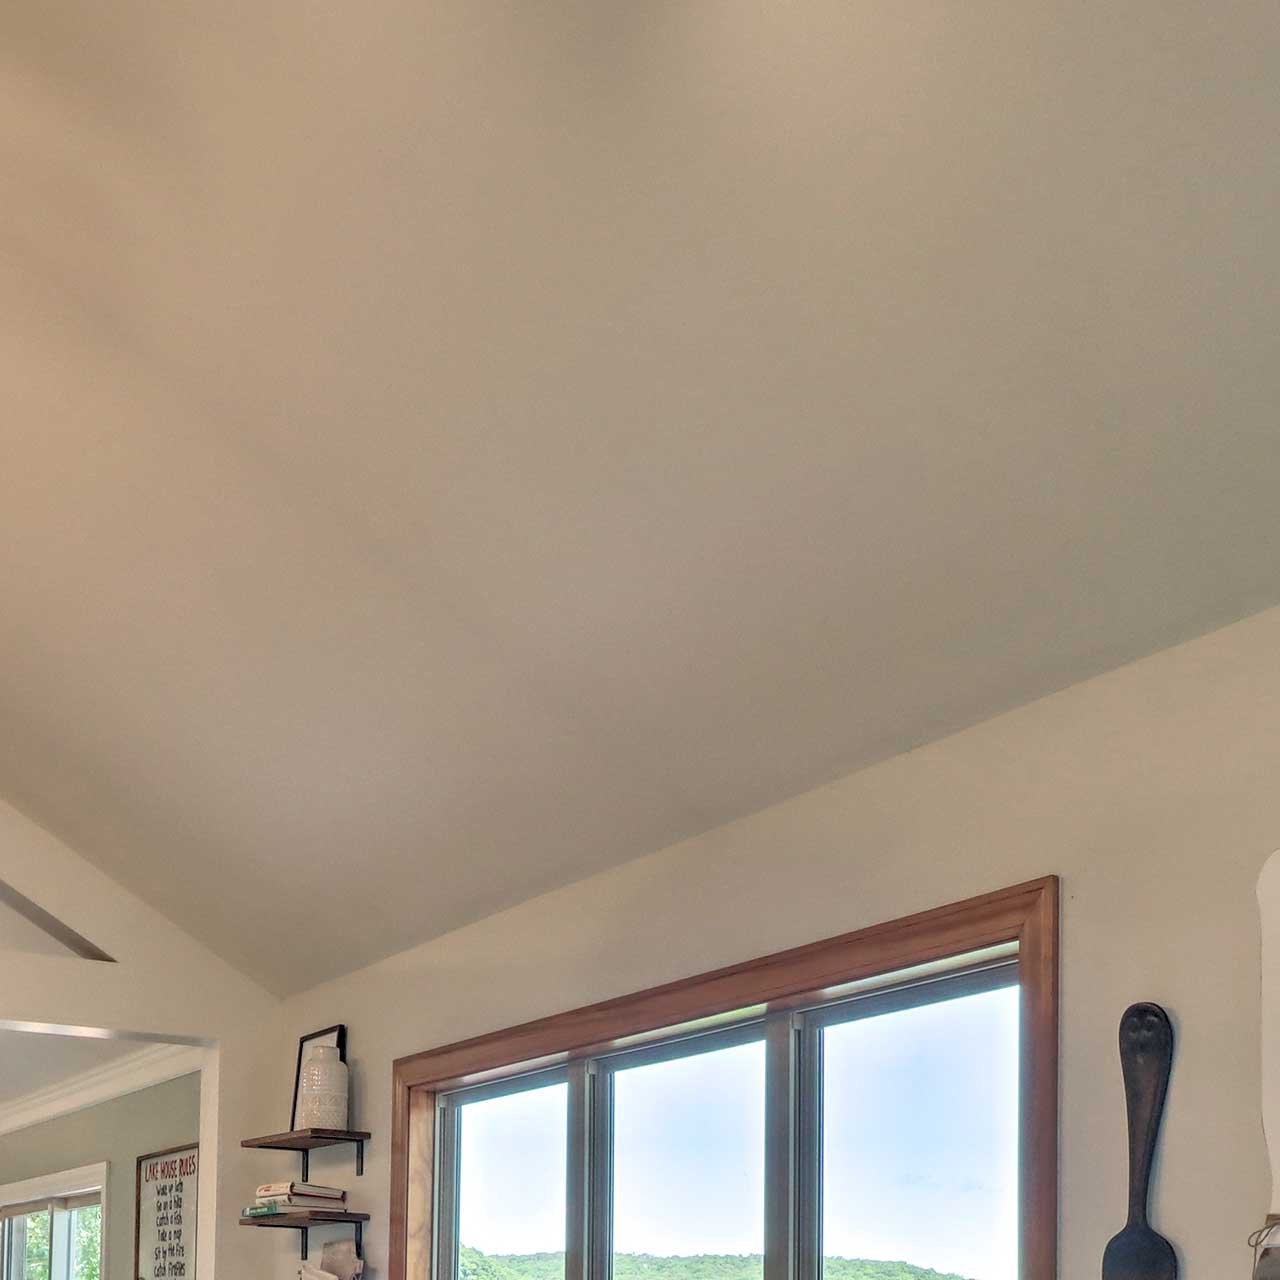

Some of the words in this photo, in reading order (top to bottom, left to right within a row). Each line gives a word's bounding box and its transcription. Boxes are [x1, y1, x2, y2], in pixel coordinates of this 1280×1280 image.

[145, 1162, 159, 1182] LAKE
[160, 1159, 177, 1180] HOUSE
[179, 1154, 196, 1177] RULES
[156, 1184, 168, 1197] Wake
[168, 1183, 174, 1198] up
[169, 1199, 173, 1210] a
[170, 1214, 174, 1225] a
[168, 1230, 172, 1241] a
[173, 1228, 182, 1243] nap
[162, 1246, 167, 1263] by
